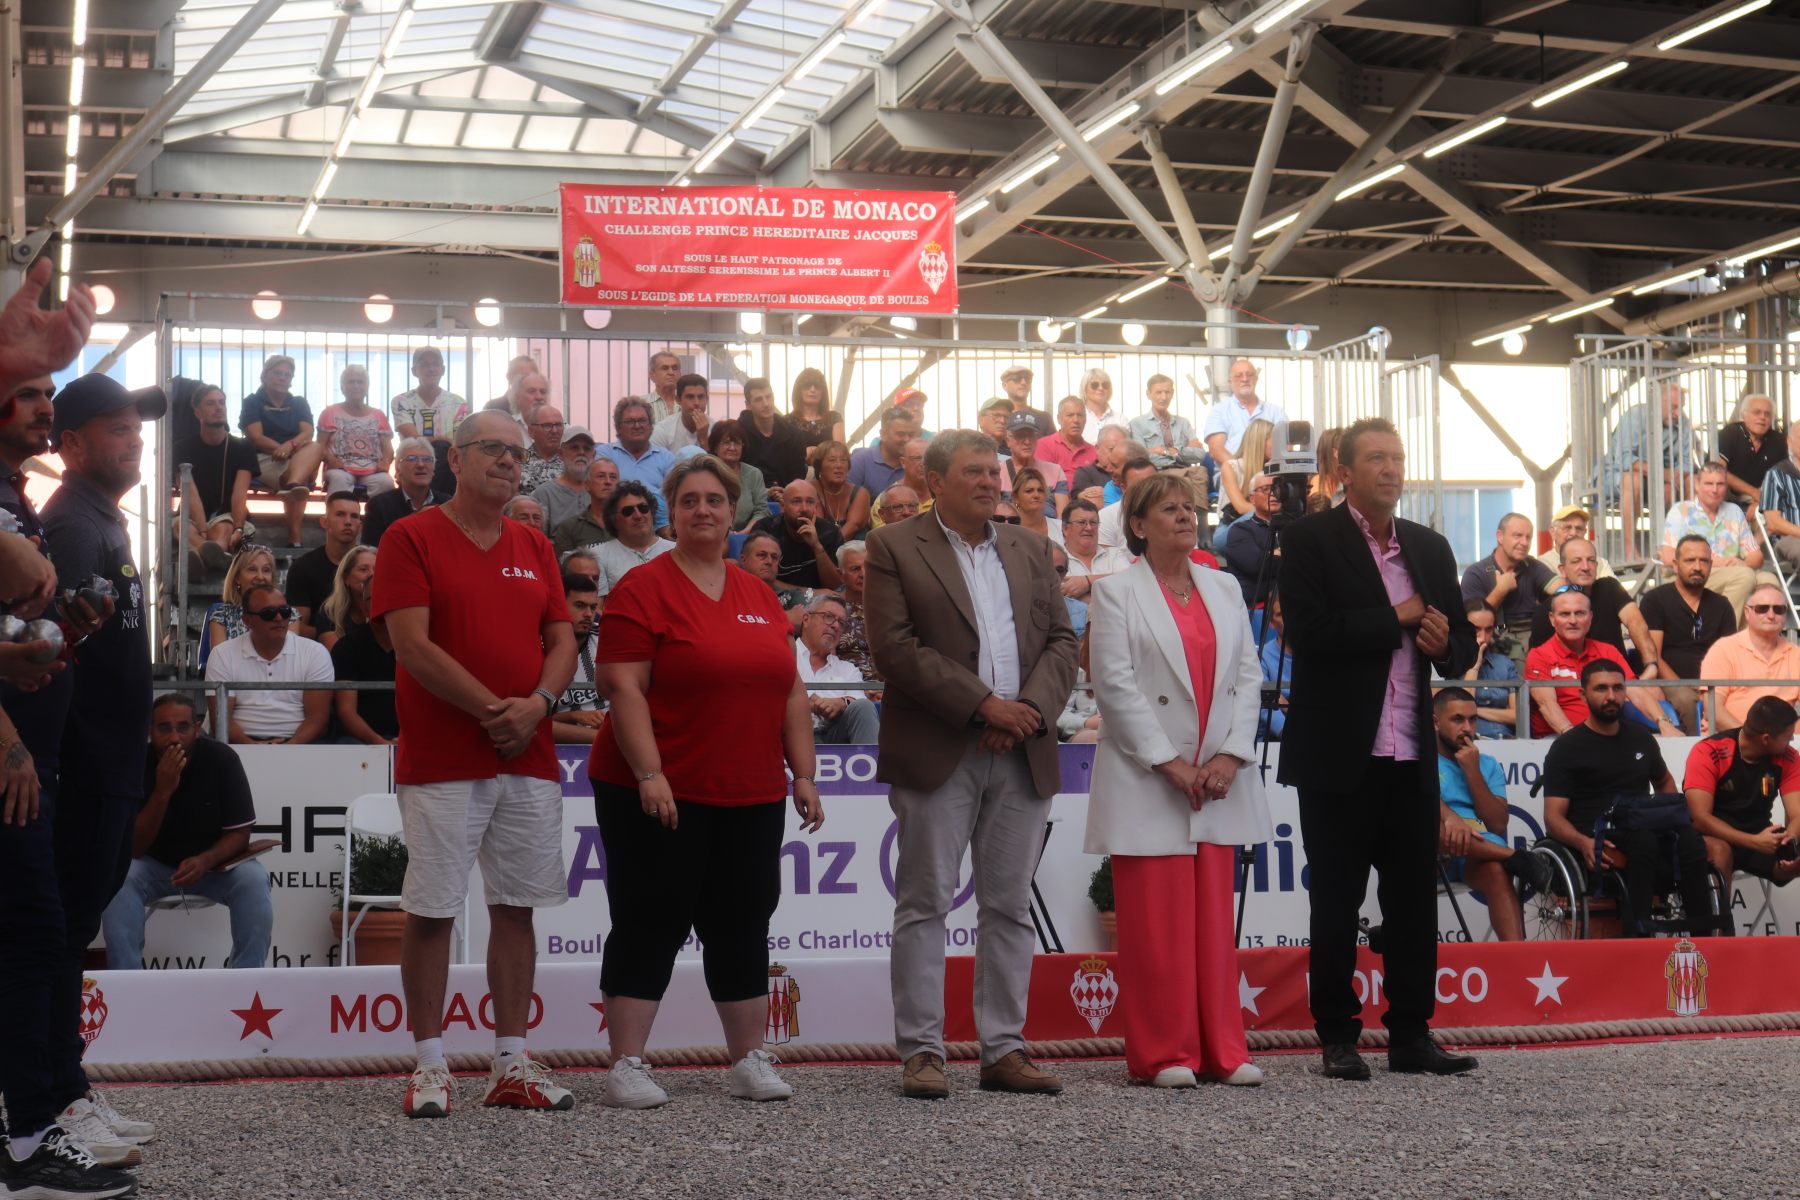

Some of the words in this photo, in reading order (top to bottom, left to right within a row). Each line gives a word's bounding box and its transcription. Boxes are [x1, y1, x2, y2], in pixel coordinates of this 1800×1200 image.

[584, 195, 784, 217] INTERNATIONAL
[792, 198, 825, 219] DE
[833, 200, 937, 221] MONACO
[604, 224, 692, 236] CHALLENGE
[695, 226, 749, 237] PRINCE
[752, 227, 850, 240] HEREDITAIRE
[853, 230, 918, 242] JACQUES
[684, 254, 712, 263] SOUS
[715, 254, 728, 264] LE
[730, 255, 759, 264] HAUT
[762, 256, 825, 266] PATRONAGE
[827, 257, 843, 266] DE
[635, 264, 657, 273] SON
[659, 265, 706, 274] ALTESSE
[708, 266, 780, 276] SERENISSIME
[782, 268, 796, 276] LE
[798, 268, 838, 276] PRINCE
[839, 269, 881, 277] ALBERT
[882, 270, 891, 278] II
[597, 289, 628, 300] SOUS
[631, 290, 676, 302] L'EGIDE
[679, 292, 696, 302] DE
[699, 292, 712, 303] LA
[715, 293, 787, 304] FEDERATION
[789, 294, 867, 307] MONEGASQUE
[869, 296, 885, 305] DE
[887, 296, 930, 305] BOULES
[501, 566, 538, 581] C.B.M.
[560, 688, 598, 706] Jee
[330, 992, 544, 1034] MOACO
